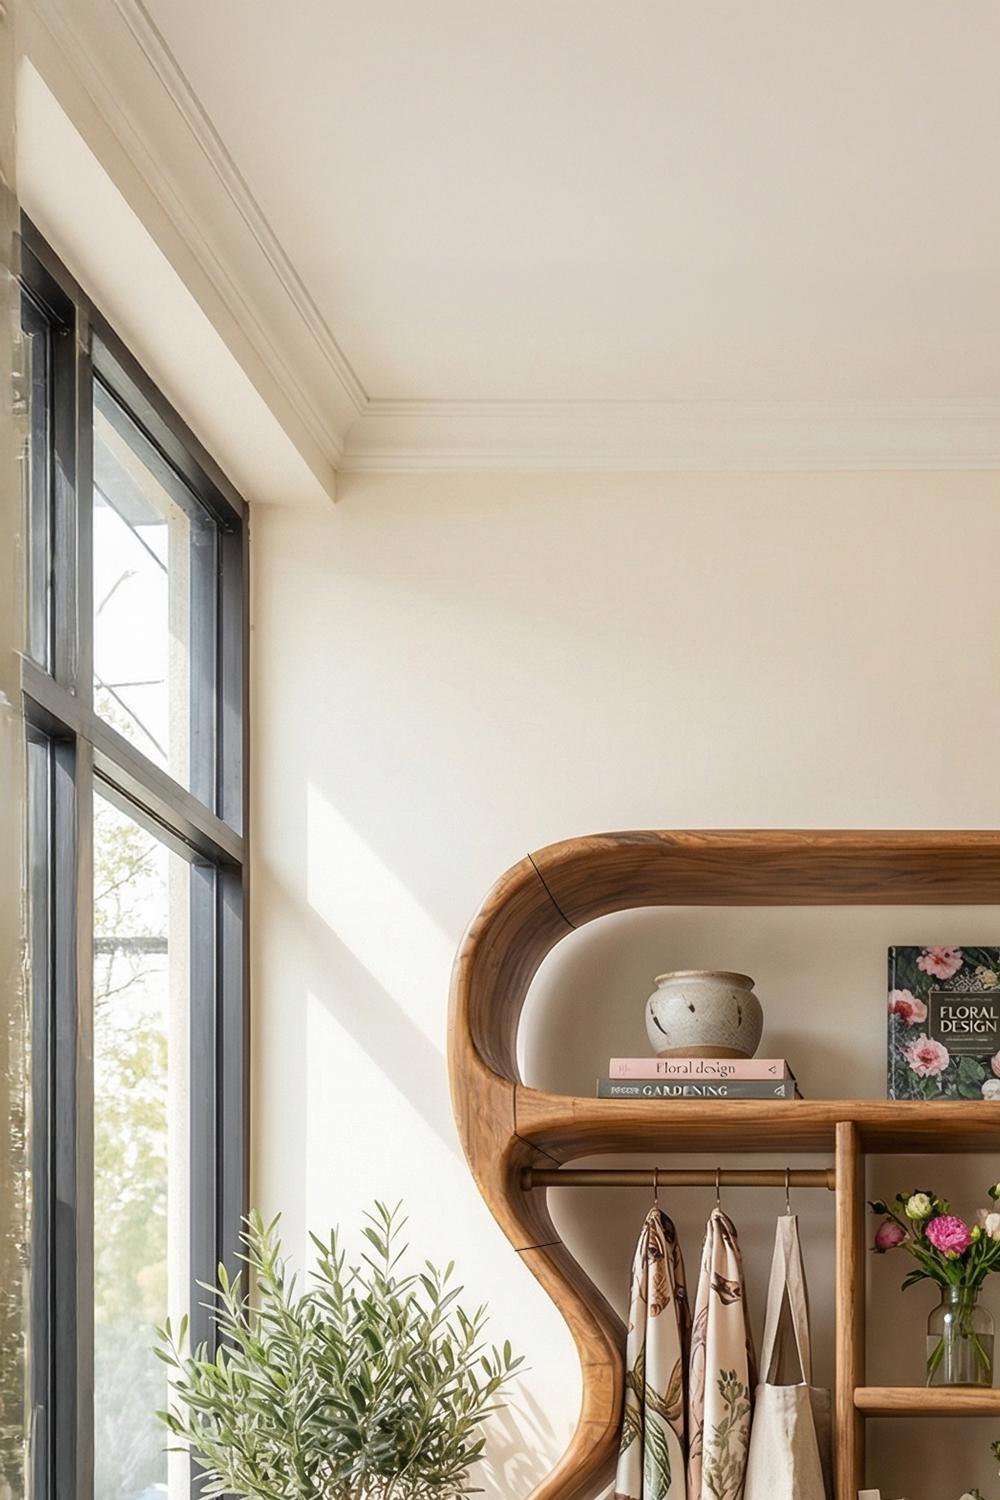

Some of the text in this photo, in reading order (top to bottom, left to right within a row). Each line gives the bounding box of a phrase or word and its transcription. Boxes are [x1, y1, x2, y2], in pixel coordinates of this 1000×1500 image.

[940, 1006, 999, 1019] FLORAL
[940, 1020, 997, 1033] DESIGN
[656, 1061, 693, 1074] Floral
[642, 1085, 728, 1097] GARDENING
